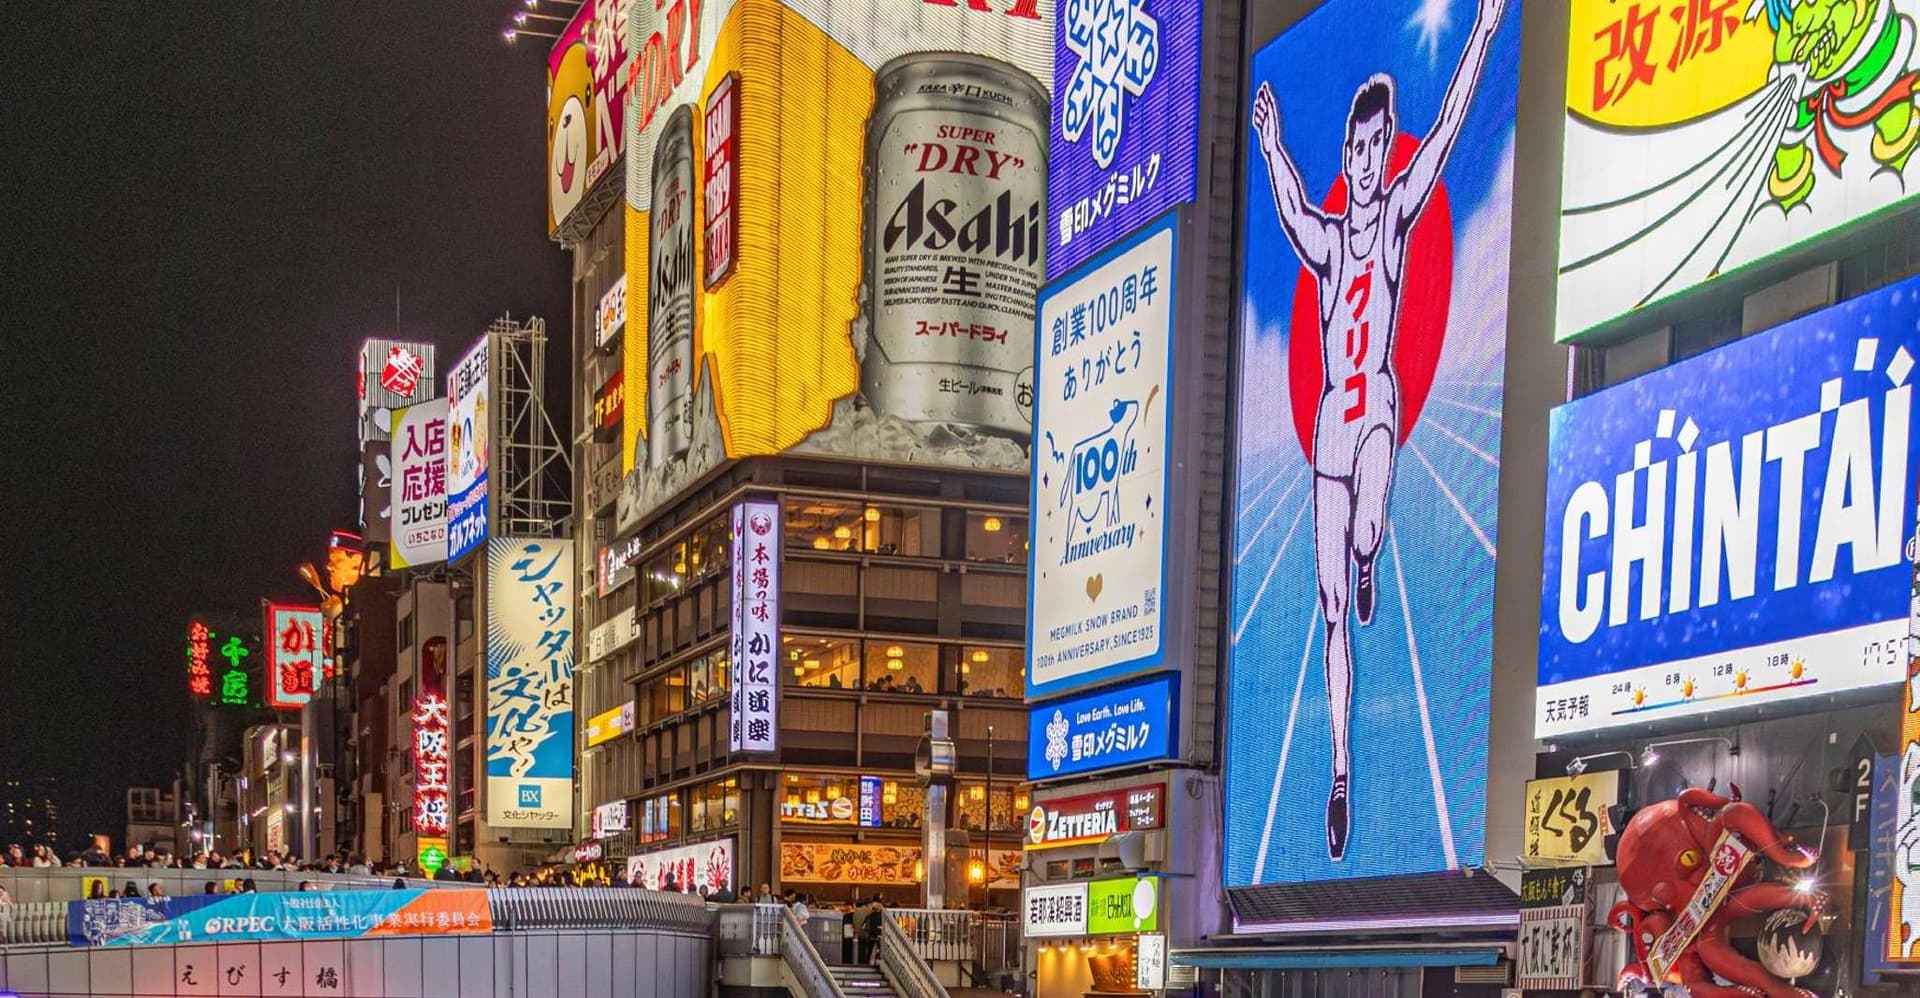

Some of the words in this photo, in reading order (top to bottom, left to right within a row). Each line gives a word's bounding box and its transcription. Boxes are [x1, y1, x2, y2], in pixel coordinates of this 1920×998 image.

[1593, 0, 1741, 111] 改源
[937, 125, 995, 145] SUPER
[1060, 152, 1161, 246] 雪印メグミルク
[884, 178, 1039, 266] Asahi
[942, 266, 981, 297] 生
[915, 320, 1008, 344] スーパードライ
[1051, 266, 1158, 356] 創業100周年
[1344, 260, 1374, 424] グリコ
[1063, 331, 1142, 401] ありがとう
[401, 419, 446, 464] 入店
[401, 458, 446, 502] 応援
[1075, 438, 1137, 494] 100th
[1558, 370, 1912, 644] CHINTAI
[1060, 523, 1136, 566] Anniversary
[1050, 619, 1082, 641] MEGMILK
[1086, 612, 1108, 633] SNOW
[1110, 604, 1139, 627] BRAND
[1713, 664, 1733, 677] 12時
[1767, 654, 1789, 667] 18時
[748, 632, 771, 742] かに道楽
[1077, 711, 1091, 725] Love
[1092, 706, 1112, 721] Earth.
[1114, 703, 1129, 717] Love
[1131, 699, 1145, 714] Life.
[1545, 695, 1590, 724] 天気予報
[416, 693, 448, 829] 大阪王将
[1071, 722, 1149, 761] 雪印メグミルク
[521, 790, 540, 802] BX
[1047, 810, 1117, 840] ZETTERIA
